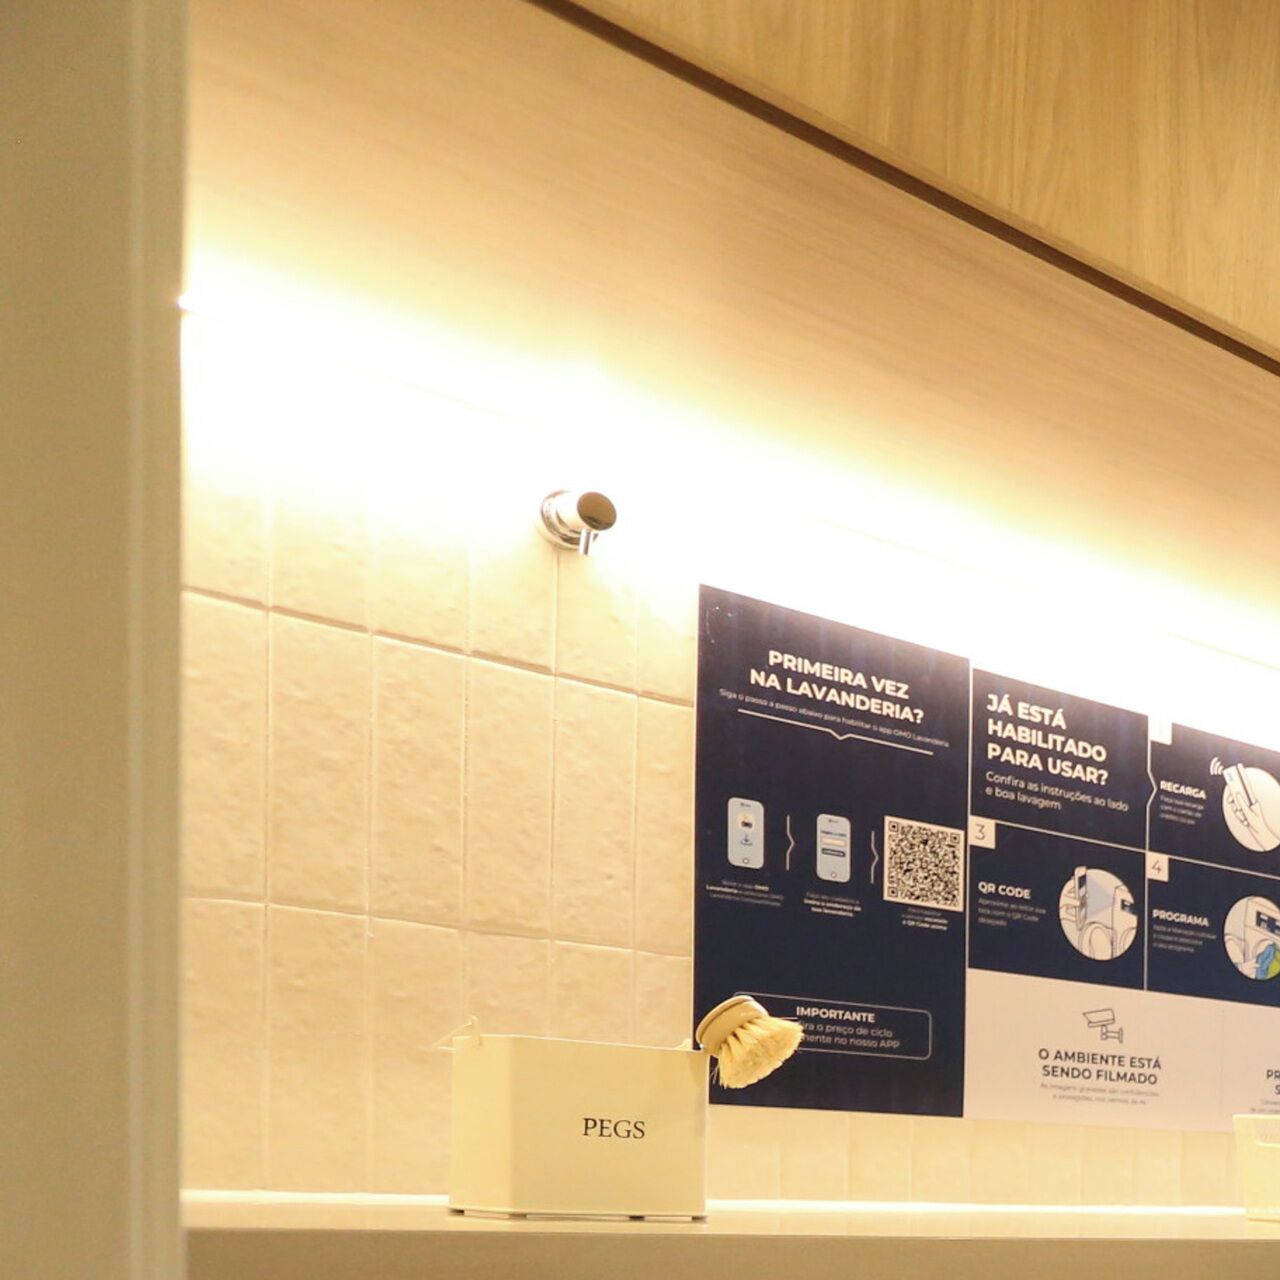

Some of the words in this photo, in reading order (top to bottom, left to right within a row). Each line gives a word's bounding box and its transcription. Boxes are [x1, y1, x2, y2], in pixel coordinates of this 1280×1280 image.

[769, 649, 868, 689] PRIMEIRA
[871, 676, 910, 700] VEZ
[750, 668, 781, 691] NA
[786, 677, 924, 724] LAVANDERIA?
[986, 693, 1013, 716] JÁ
[1017, 701, 1067, 730] ESTÁ
[988, 718, 1107, 762] HABILITADO
[988, 743, 1043, 771] PARA
[1048, 757, 1109, 785] USAR?
[985, 787, 992, 796] e
[994, 786, 1015, 800] boa
[1017, 790, 1062, 810] lavagem
[986, 771, 1026, 790] Confira
[1027, 781, 1039, 792] as
[1041, 782, 1093, 805] instruções
[1094, 797, 1105, 808] ao
[1107, 798, 1129, 812] lado
[1160, 780, 1207, 800] RECARGA
[975, 823, 986, 841] 3
[1151, 859, 1162, 874] 4
[978, 881, 996, 895] QR
[998, 885, 1031, 900] CODE
[1152, 909, 1210, 928] PROGRAMA
[796, 1006, 876, 1023] IMPORTANTE
[826, 1025, 852, 1036] preço
[855, 1026, 868, 1036] de
[870, 1027, 893, 1038] ciclo
[834, 1037, 847, 1046] no
[849, 1038, 878, 1048] nosso
[879, 1040, 900, 1049] APP
[1038, 1048, 1049, 1060] O
[1054, 1050, 1126, 1068] AMBIENTE
[1129, 1056, 1162, 1071] ESTÁ
[1042, 1065, 1093, 1080] SENDO
[1096, 1069, 1158, 1085] FILMADO
[583, 1118, 645, 1139] PEGS
